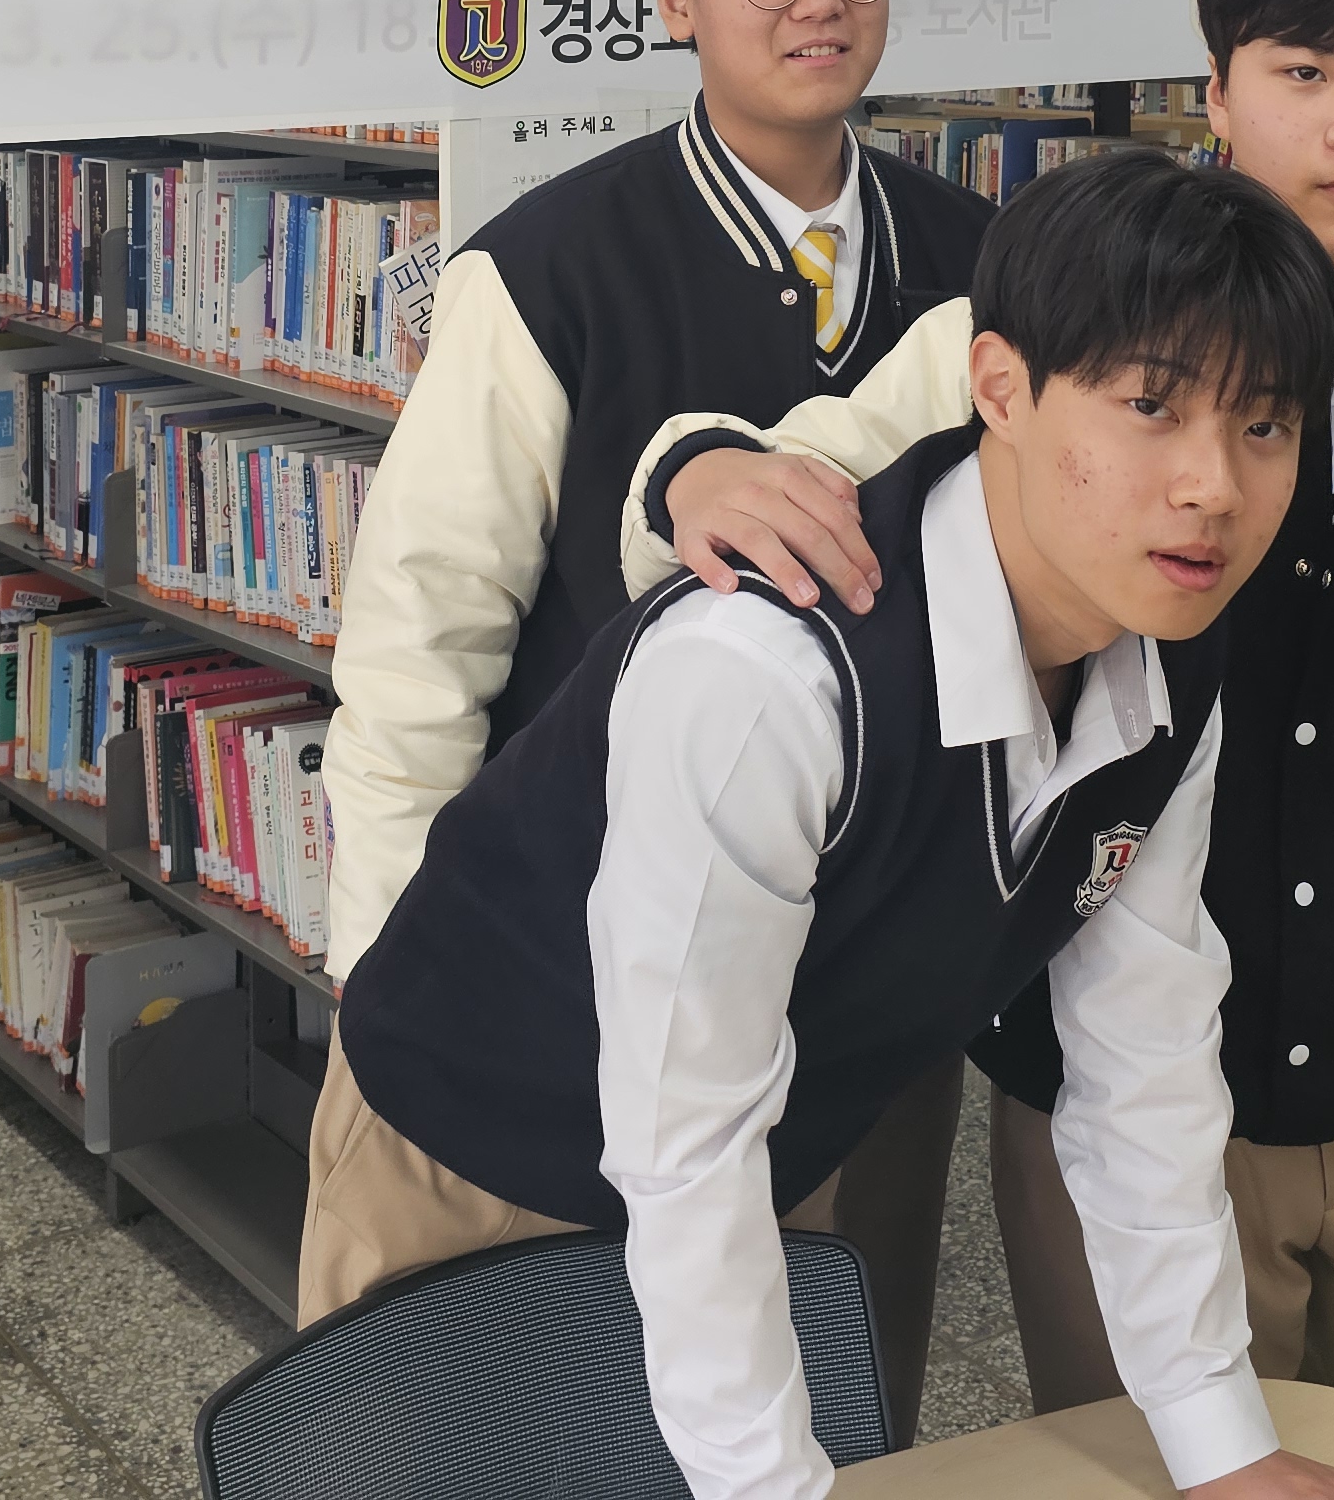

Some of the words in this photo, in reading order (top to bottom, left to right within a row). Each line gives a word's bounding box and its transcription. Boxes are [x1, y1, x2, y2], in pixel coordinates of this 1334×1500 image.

[470, 60, 493, 73] 1974
[513, 120, 548, 142] 올려
[561, 116, 616, 136] 주세요
